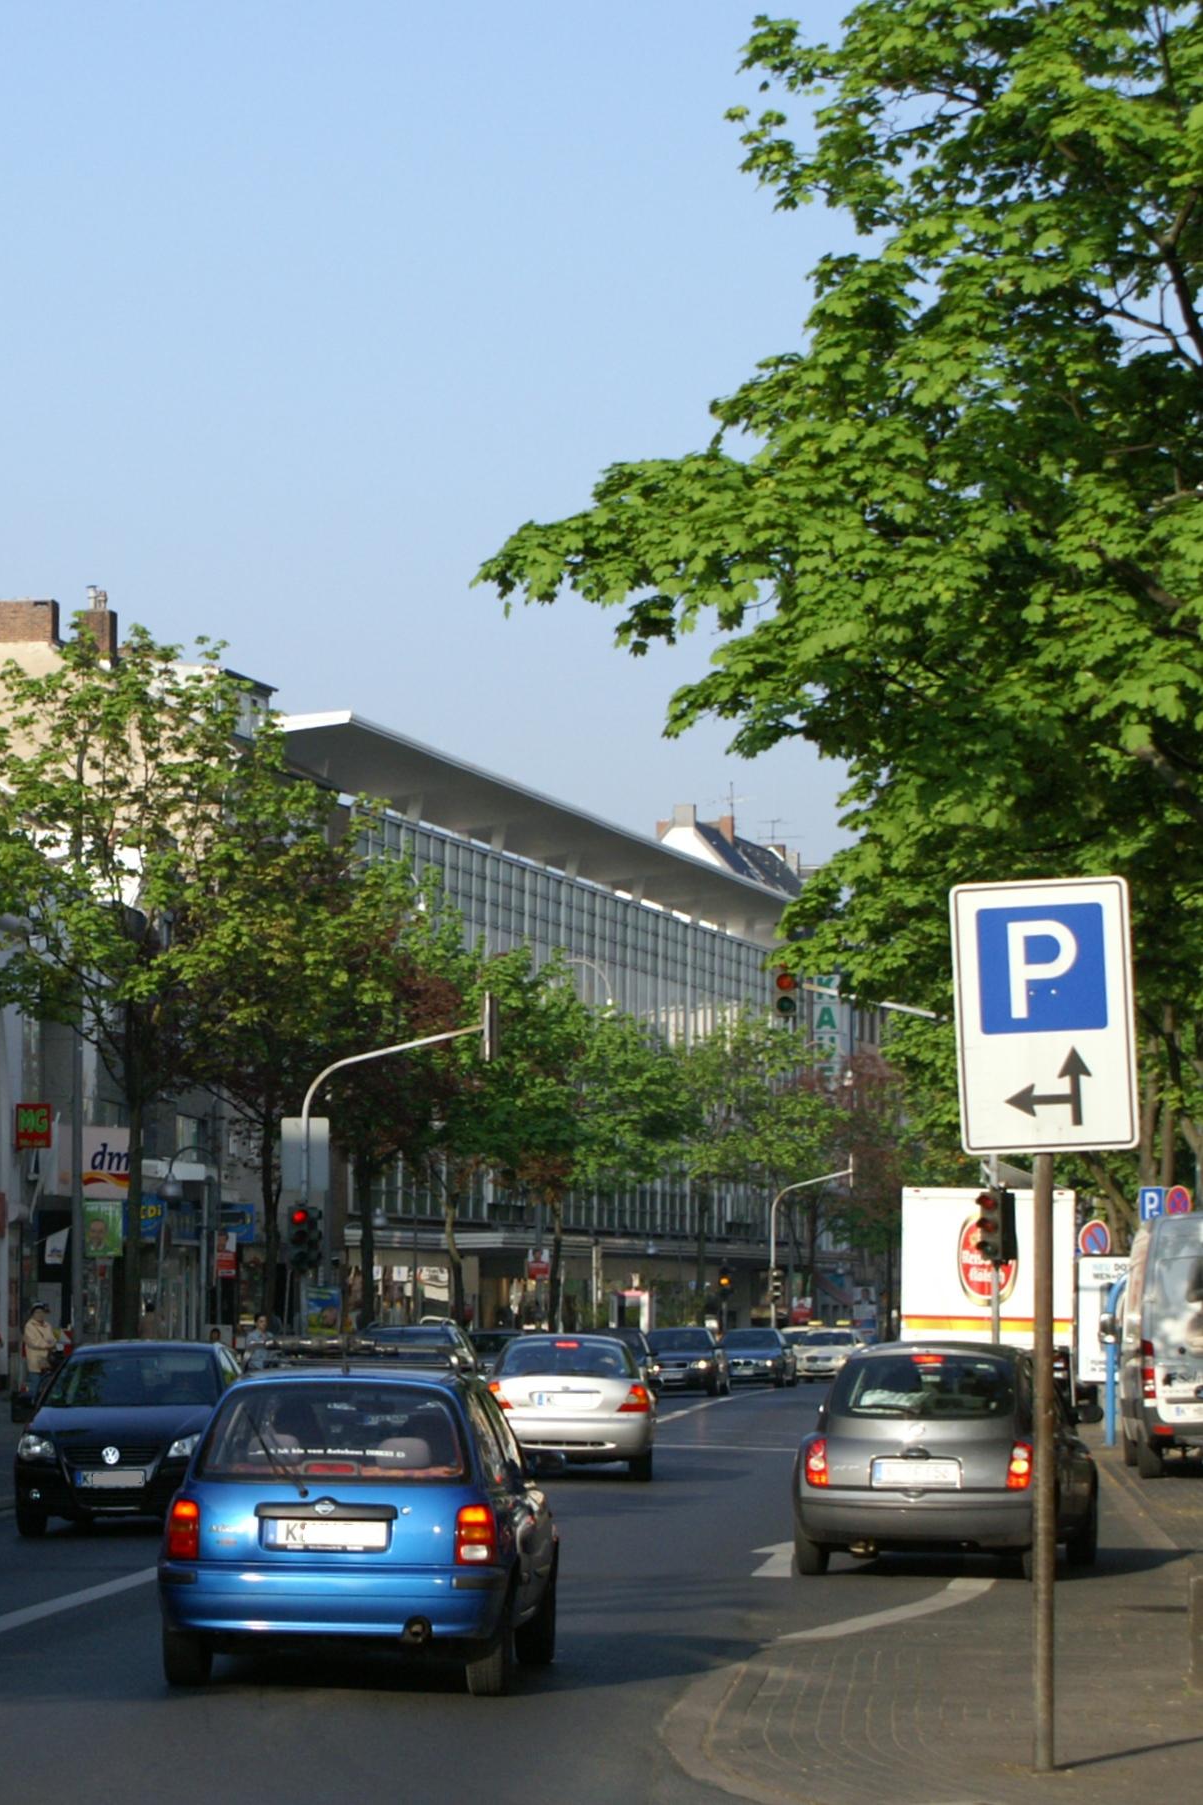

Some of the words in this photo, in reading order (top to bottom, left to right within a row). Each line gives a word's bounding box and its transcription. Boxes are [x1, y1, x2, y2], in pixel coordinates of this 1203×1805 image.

[1008, 919, 1077, 1019] P
[18, 1107, 48, 1133] MG
[91, 1142, 131, 1171] dm
[1144, 1191, 1159, 1219] P
